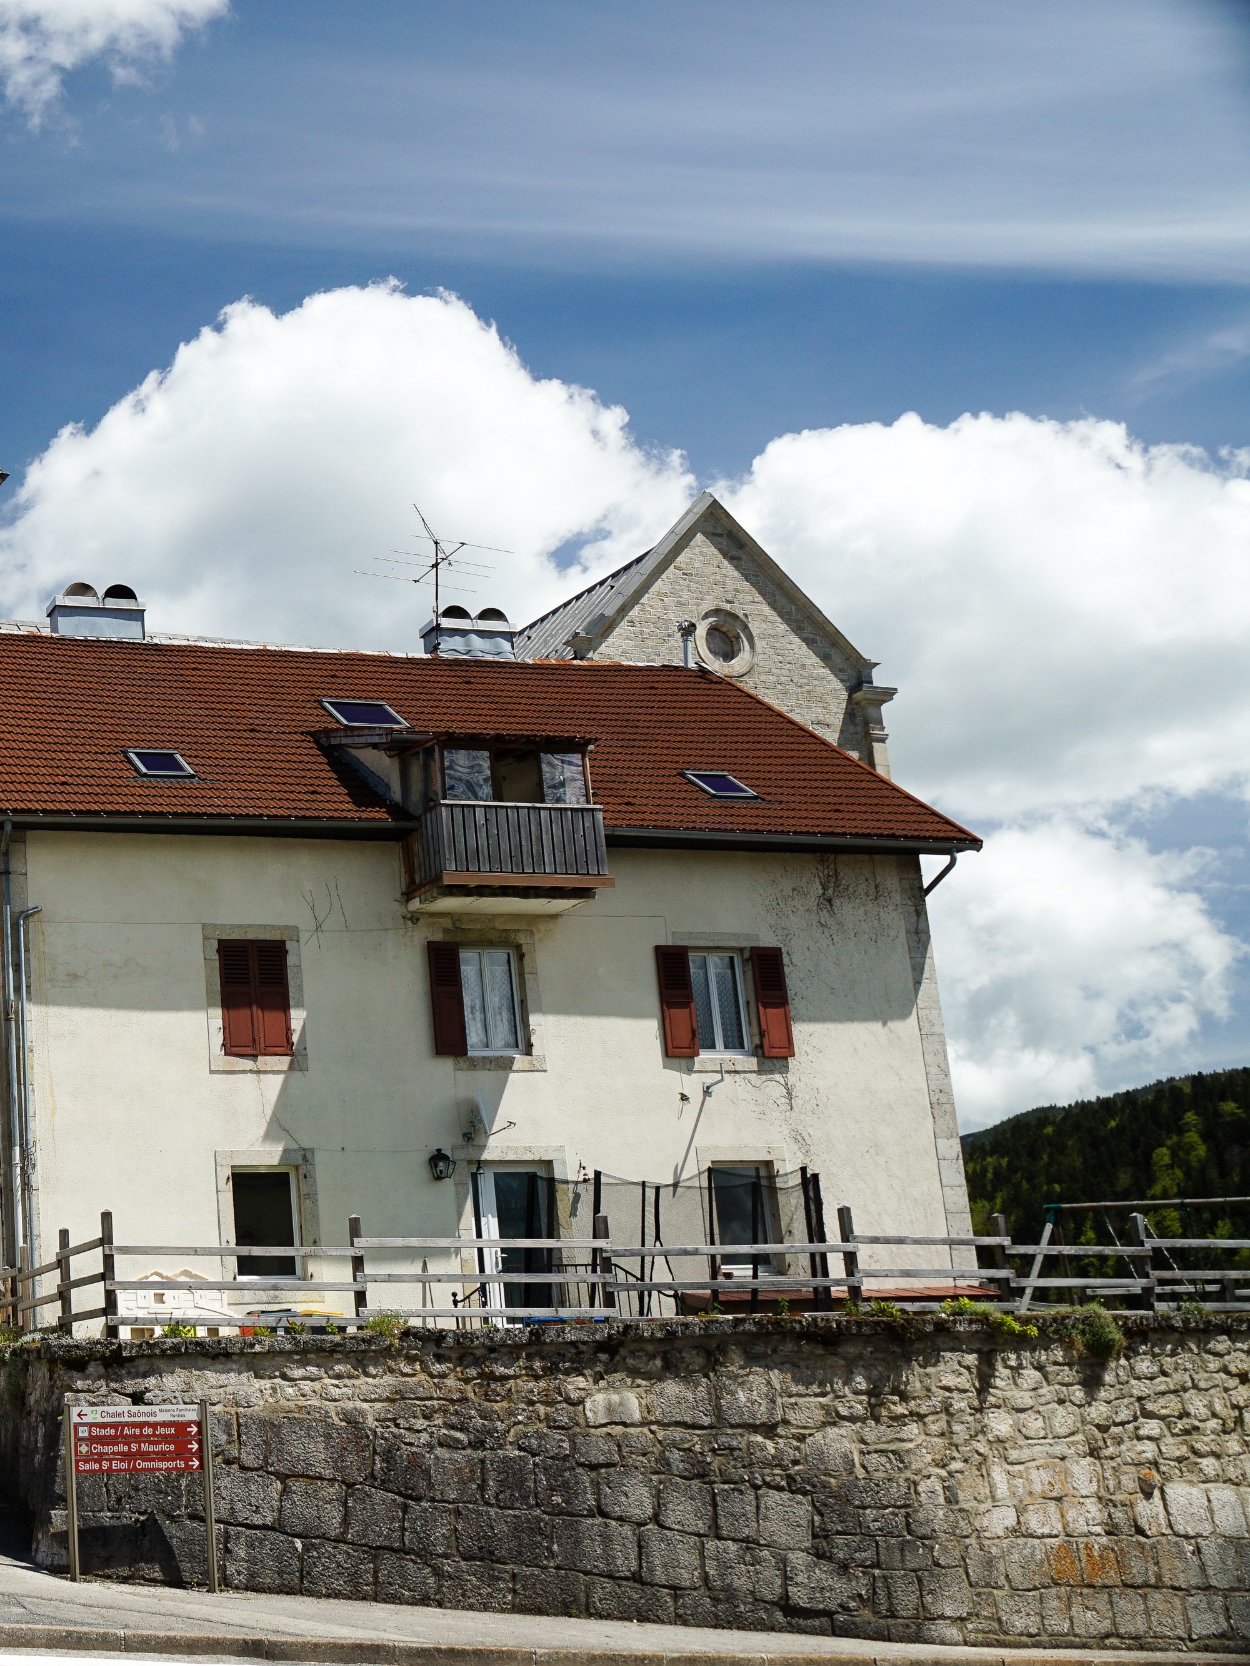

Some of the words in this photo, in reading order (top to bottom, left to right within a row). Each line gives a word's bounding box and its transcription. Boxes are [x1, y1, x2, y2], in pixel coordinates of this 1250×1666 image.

[100, 1410, 125, 1418] Chalet
[127, 1409, 158, 1418] Saônois
[91, 1426, 116, 1436] Stade
[118, 1426, 122, 1436] /
[124, 1426, 140, 1435] Aire
[142, 1426, 153, 1434] de
[156, 1426, 176, 1434] Jeux
[92, 1444, 128, 1454] Chapelle
[140, 1442, 175, 1452] Maurice
[78, 1461, 100, 1470] Salle
[112, 1460, 128, 1470] Eloi
[130, 1460, 134, 1469] /
[136, 1460, 185, 1470] Omnisports
